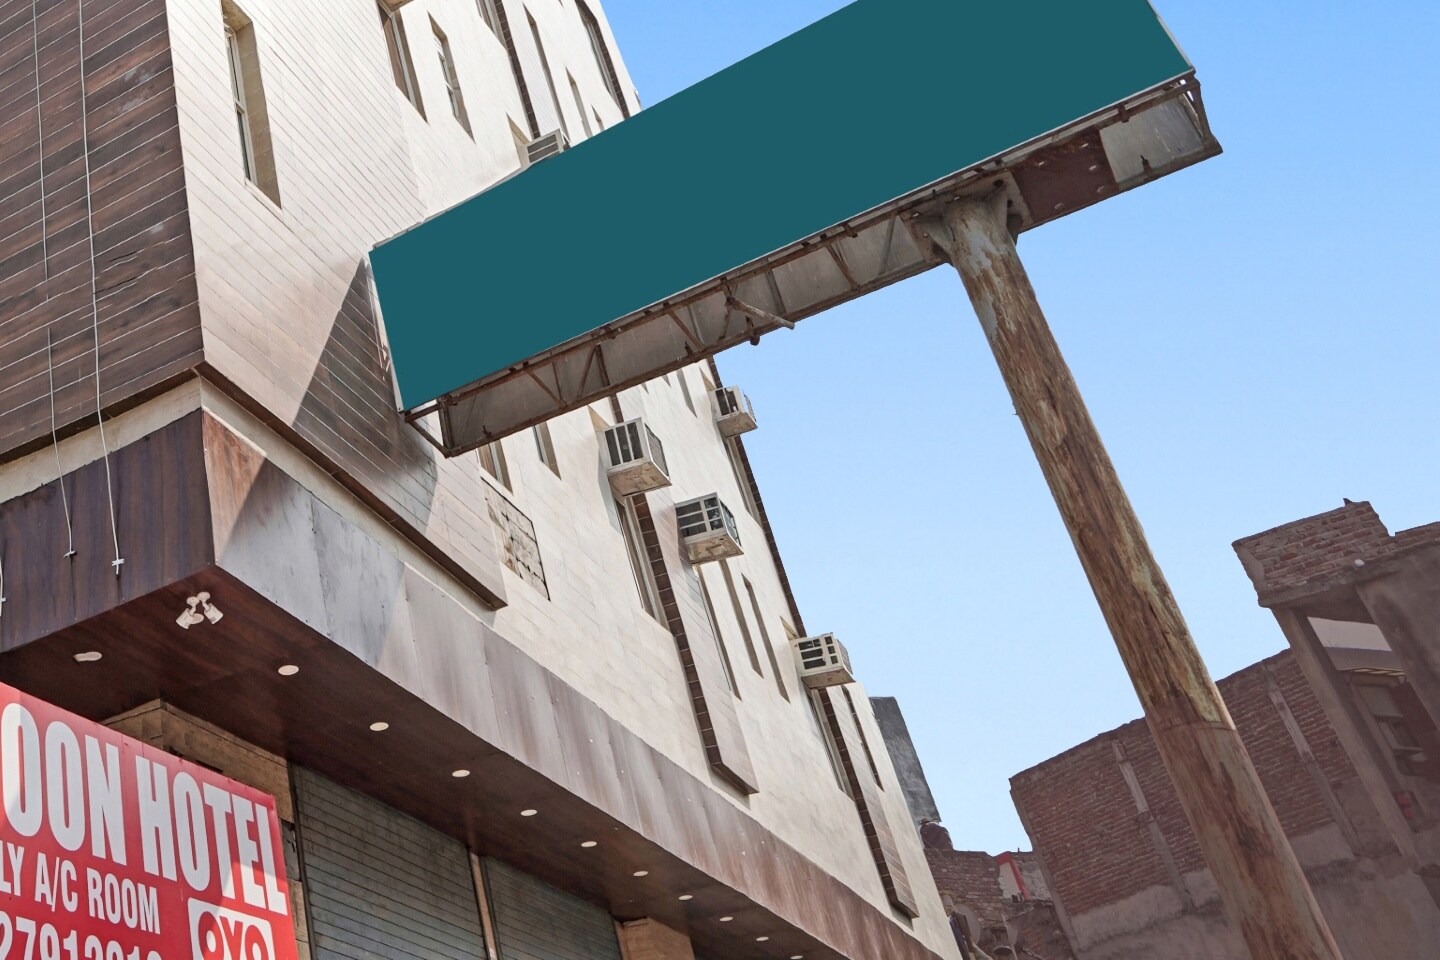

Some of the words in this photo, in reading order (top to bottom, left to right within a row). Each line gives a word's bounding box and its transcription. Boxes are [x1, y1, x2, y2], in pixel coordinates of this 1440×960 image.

[135, 755, 288, 916] HOTEL
[35, 851, 78, 912] A/C
[86, 867, 161, 935] ROOM
[198, 911, 270, 960] OYO
